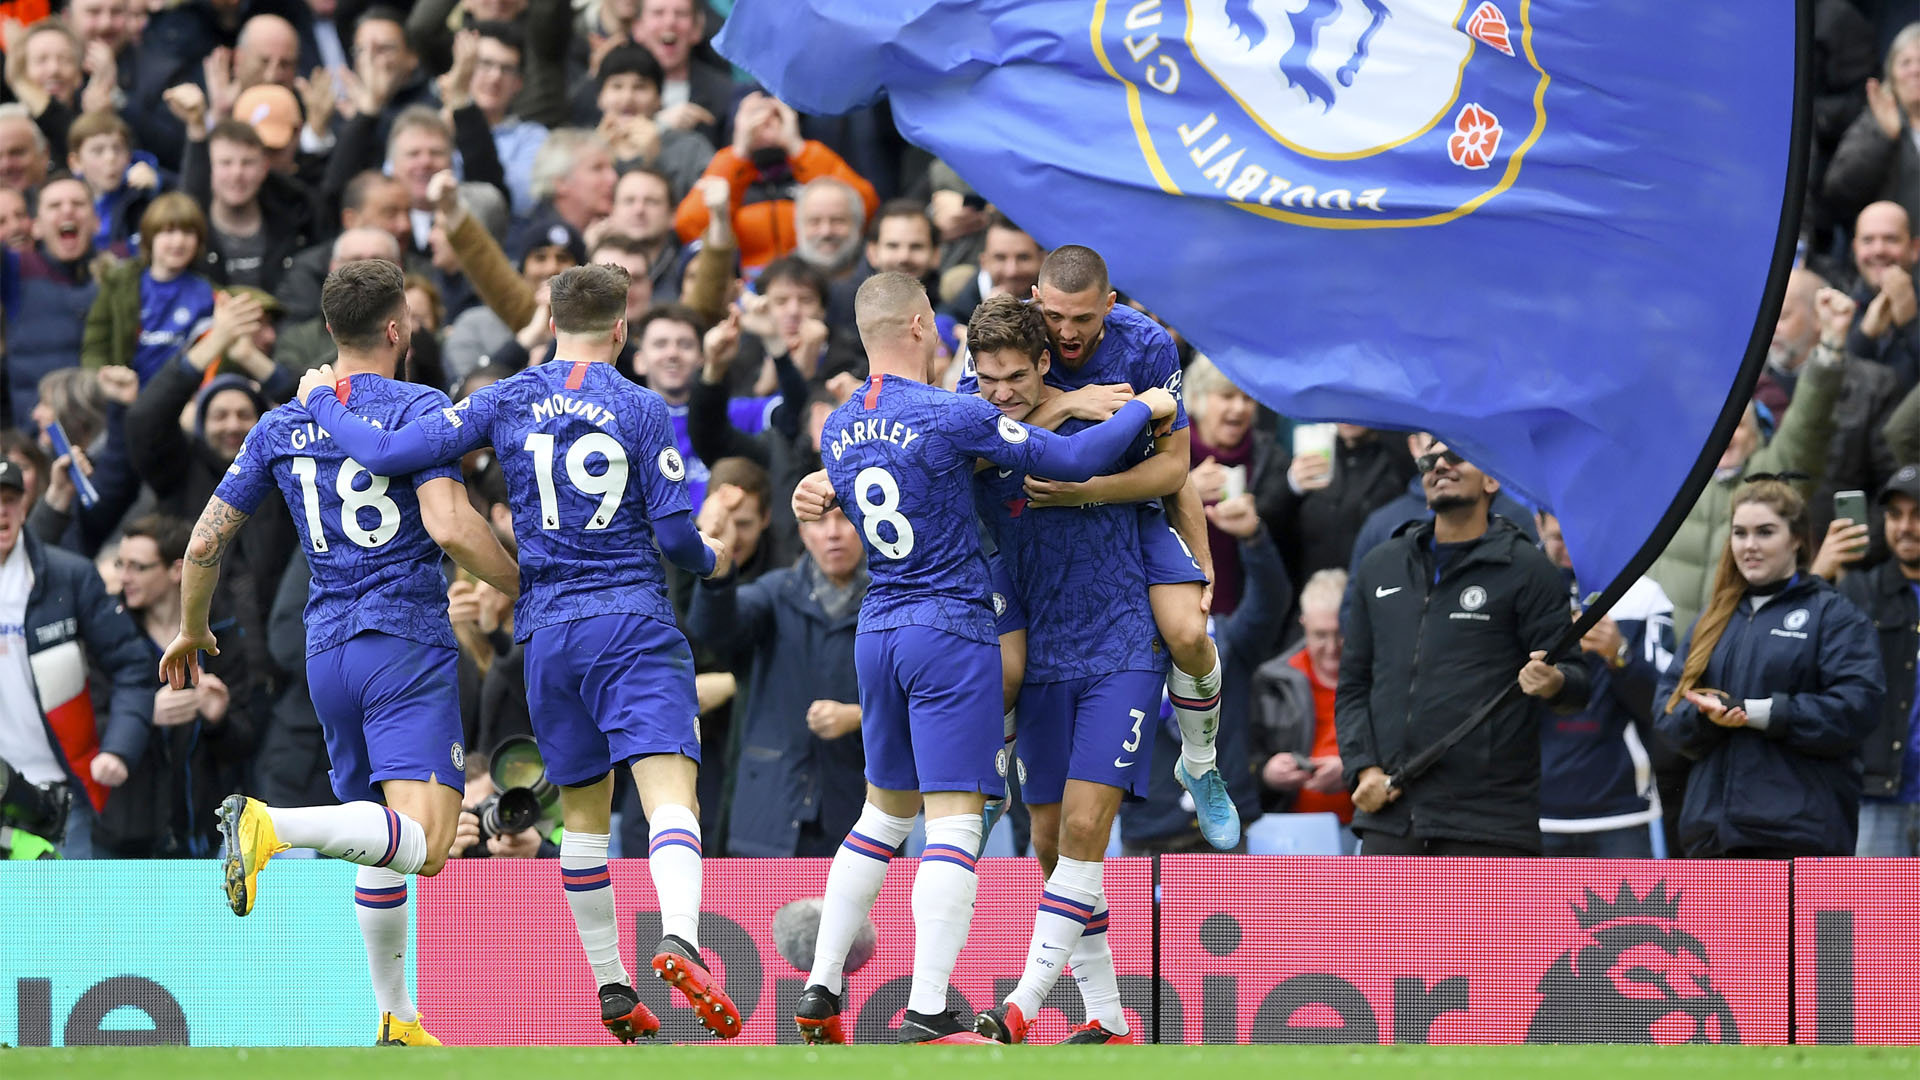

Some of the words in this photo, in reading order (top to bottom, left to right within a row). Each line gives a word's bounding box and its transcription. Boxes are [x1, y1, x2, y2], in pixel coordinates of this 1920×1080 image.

[531, 394, 615, 427] MOUNT
[831, 418, 919, 461] BARKLEY
[524, 432, 629, 530] 19
[291, 457, 401, 553] 18
[854, 466, 915, 560] 8
[1122, 708, 1146, 753] 3
[1036, 957, 1055, 969] CFC
